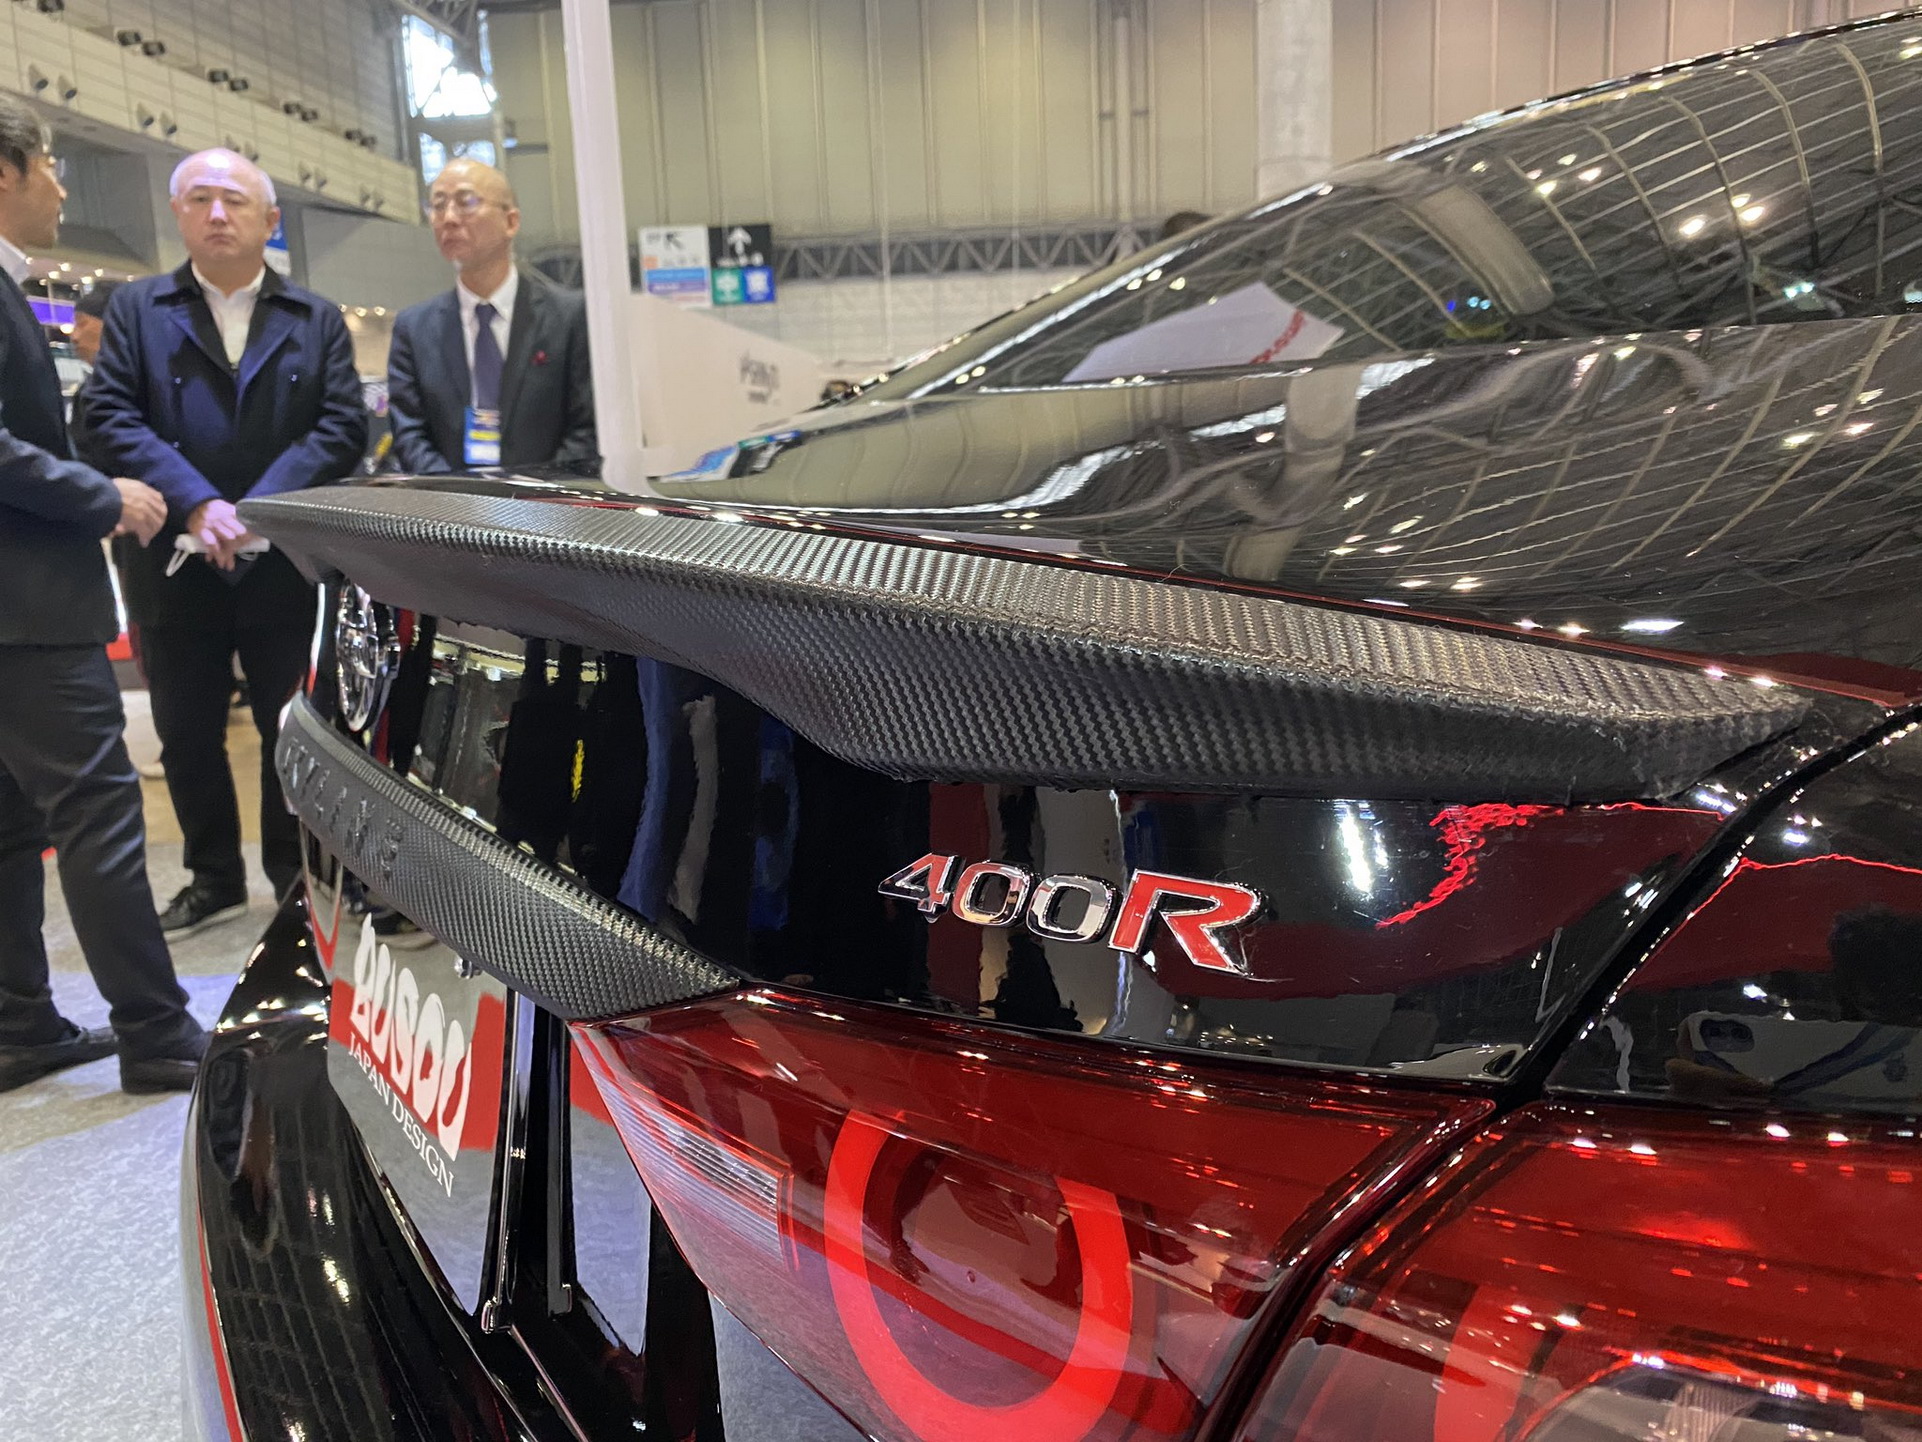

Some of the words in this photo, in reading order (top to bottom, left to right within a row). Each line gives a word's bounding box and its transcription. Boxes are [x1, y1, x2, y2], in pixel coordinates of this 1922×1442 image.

[878, 852, 1267, 977] 400R
[348, 1032, 391, 1107] JAPAN
[392, 1099, 455, 1198] DESIGN
[350, 912, 473, 1162] BUSOU
